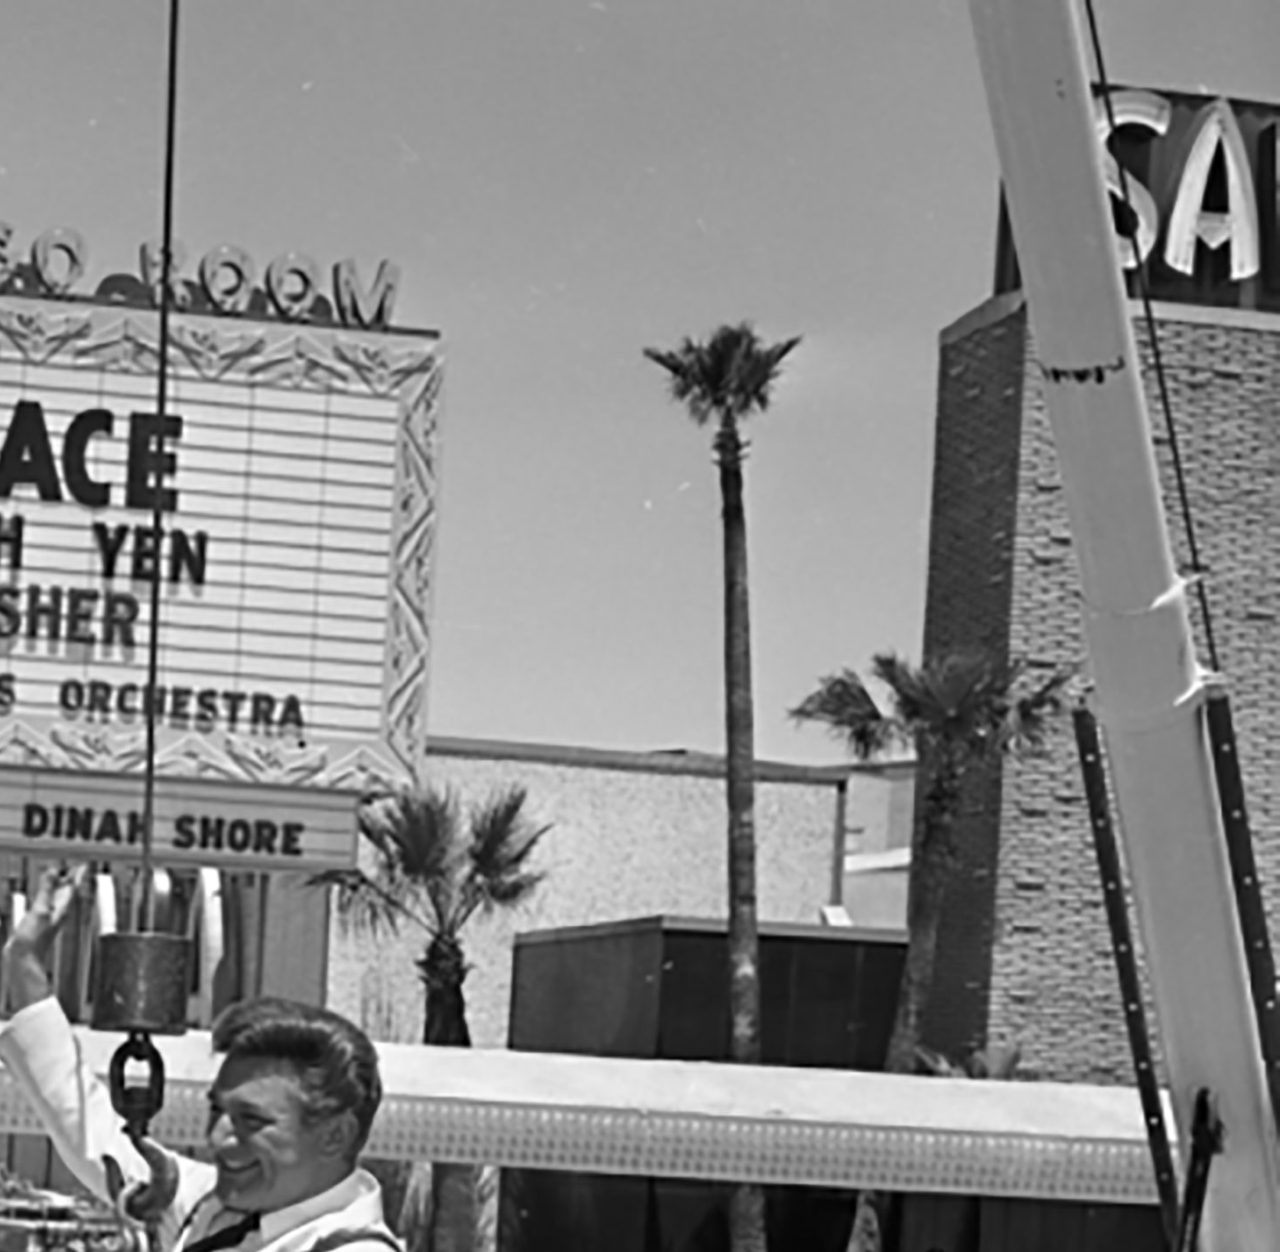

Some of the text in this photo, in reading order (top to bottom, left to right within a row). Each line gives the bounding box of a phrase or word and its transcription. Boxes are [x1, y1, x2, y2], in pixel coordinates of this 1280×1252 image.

[140, 240, 400, 332] ROOM
[93, 521, 209, 587] YEN
[58, 678, 305, 730] ORCHESTRA
[22, 802, 151, 845] DINAH
[172, 814, 306, 857] SHORE
